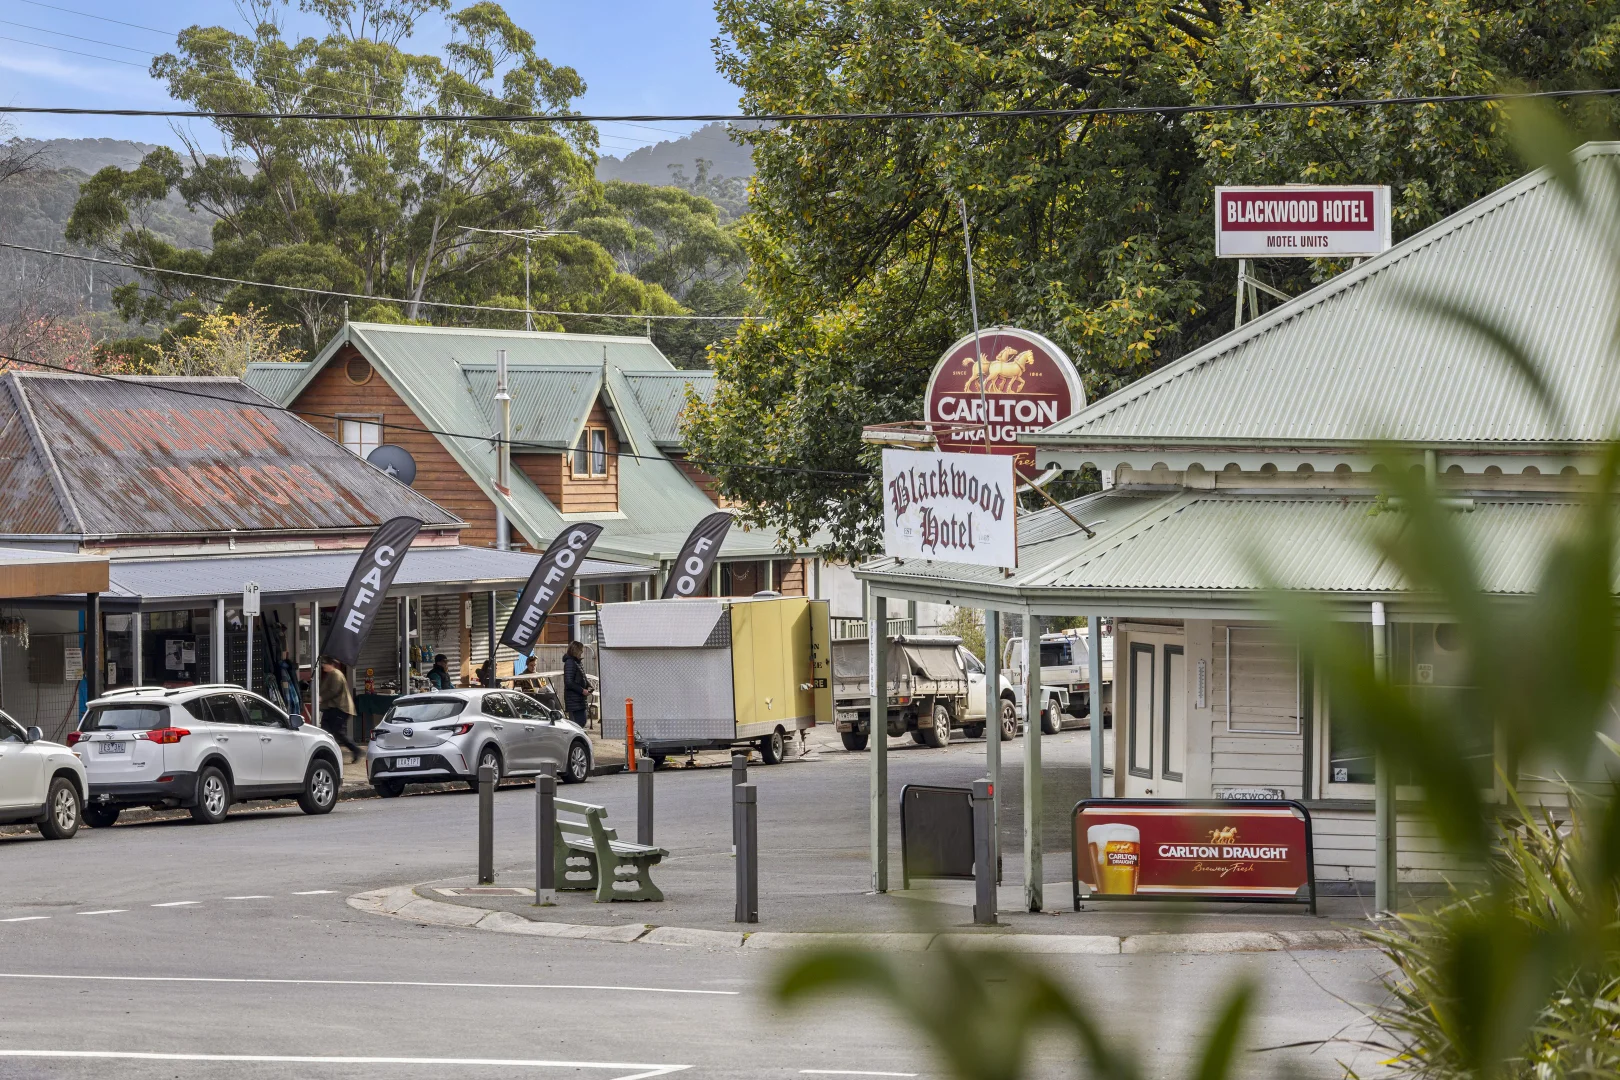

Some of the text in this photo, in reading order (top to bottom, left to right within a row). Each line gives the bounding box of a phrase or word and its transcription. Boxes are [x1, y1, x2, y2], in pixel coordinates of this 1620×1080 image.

[1227, 200, 1368, 223] BLACKWOOD HOTEL
[1267, 236, 1329, 248] MOTEL UNITS
[937, 396, 1058, 423] CARLTON
[888, 458, 1006, 528] Blackwood
[919, 506, 975, 555] Hotel
[343, 545, 396, 634] CAFE
[511, 530, 588, 647] COFFEE
[1108, 853, 1138, 861] CARLTON
[1158, 845, 1288, 860] CARLTON DRAUGHT
[1230, 862, 1255, 873] Fresh
